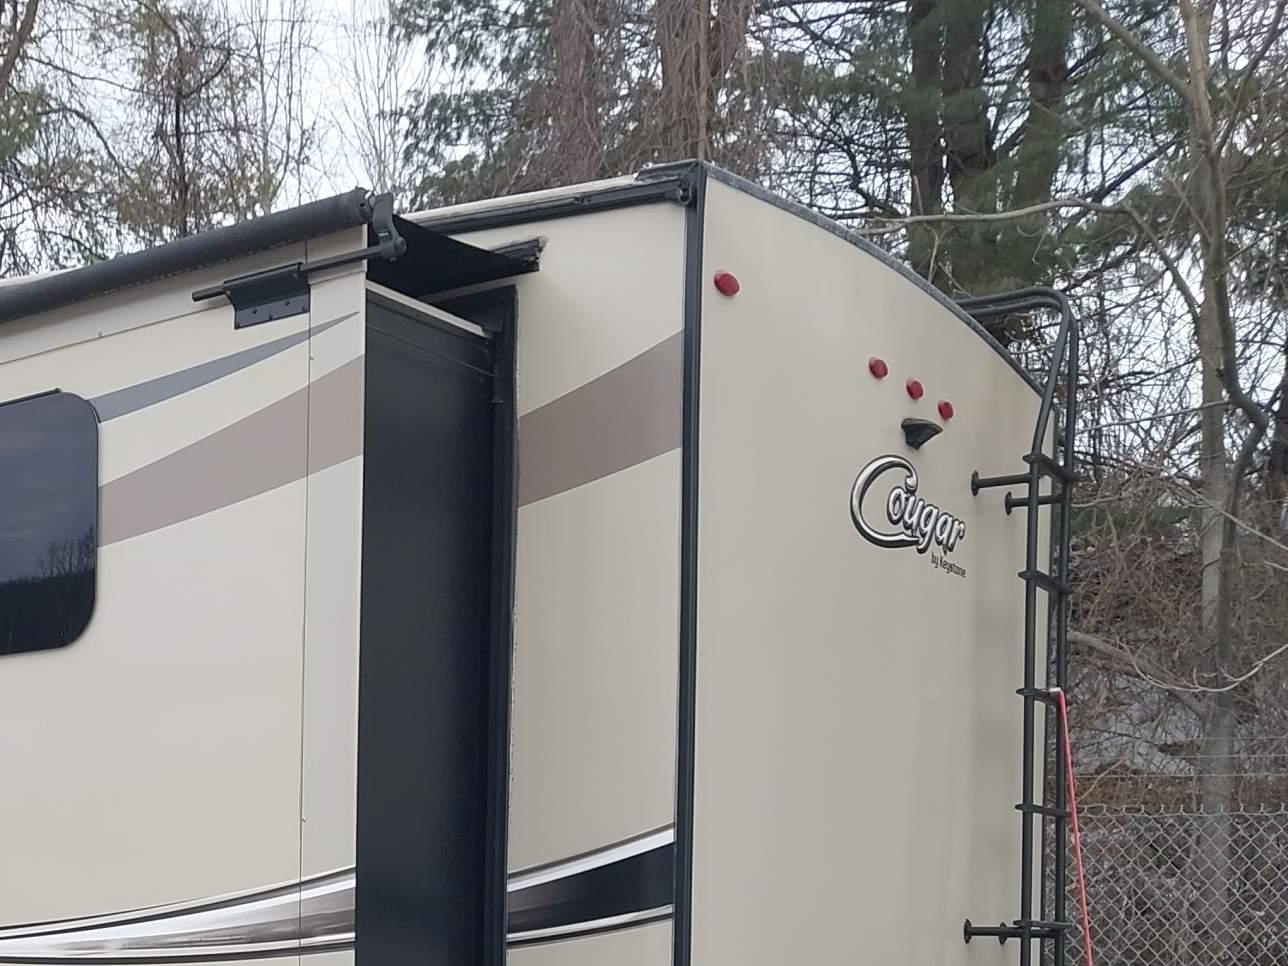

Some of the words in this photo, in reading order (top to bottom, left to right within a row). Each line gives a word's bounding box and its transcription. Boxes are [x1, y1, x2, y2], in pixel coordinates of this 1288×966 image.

[850, 454, 965, 555] Cougar
[930, 551, 939, 569] by
[939, 555, 967, 578] Keystone
